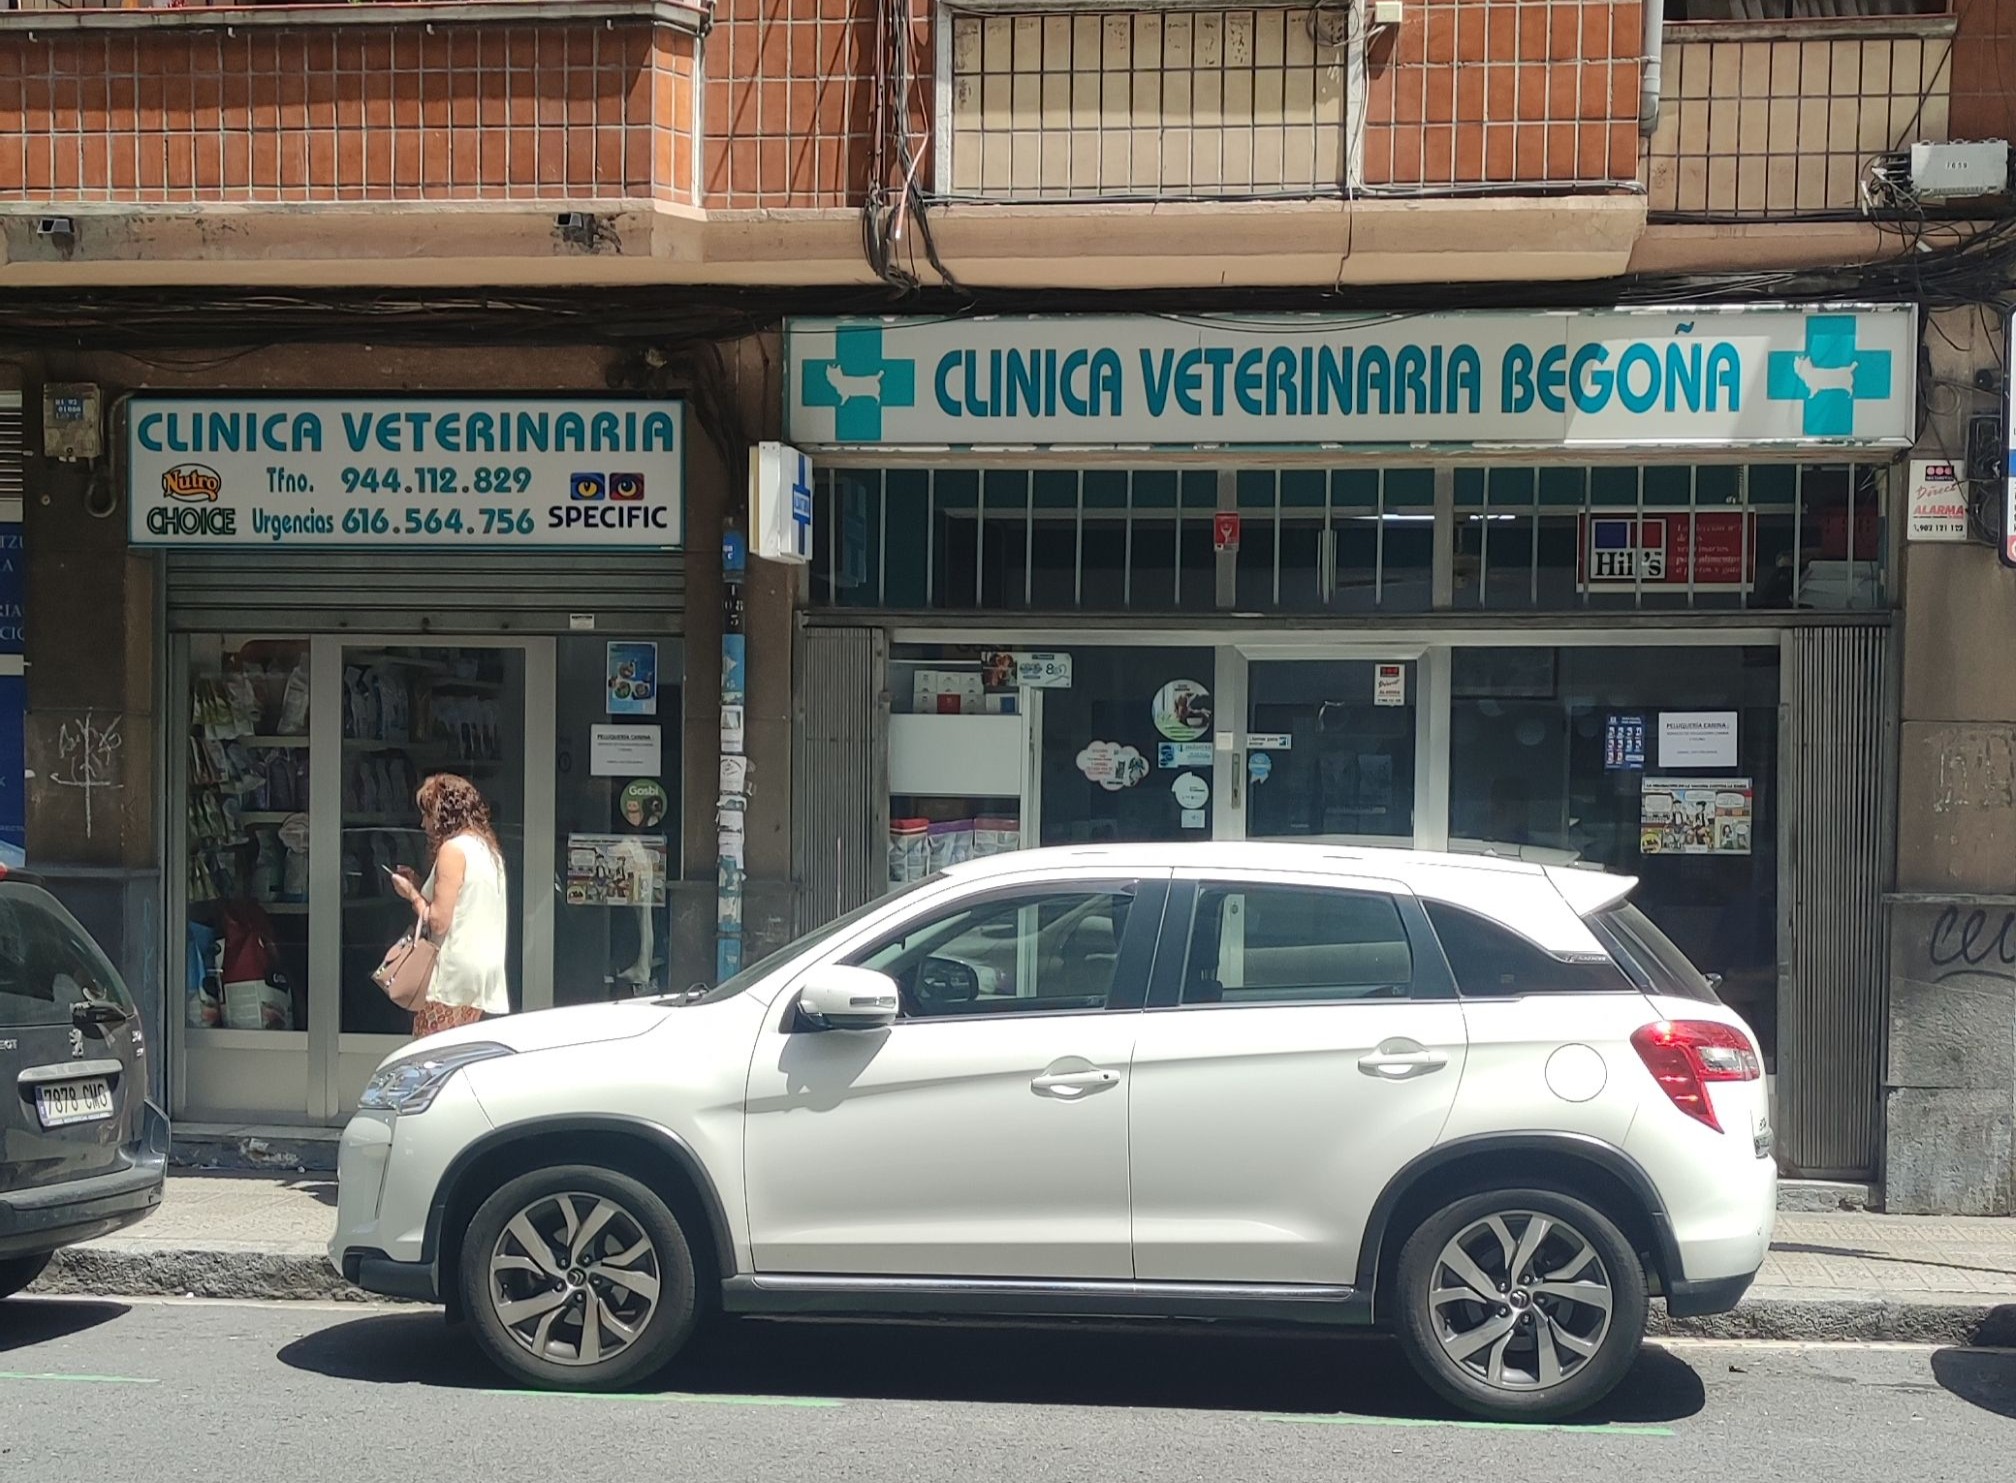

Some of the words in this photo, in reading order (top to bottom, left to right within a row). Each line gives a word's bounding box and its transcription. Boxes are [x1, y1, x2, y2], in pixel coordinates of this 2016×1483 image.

[934, 347, 1122, 418] CLINICA
[1139, 344, 1481, 417] VETERINARIA
[1501, 321, 1741, 413] BEGOÑA
[138, 412, 322, 452] CLINICA
[341, 412, 674, 452] VETERINARIA
[163, 469, 219, 496] Nutro
[266, 467, 314, 493] Tfno.
[341, 467, 532, 494] 944.112.829
[147, 506, 236, 535] CHOICE
[548, 506, 668, 529] SPECIFIC
[1913, 505, 1964, 515] ALARMA
[252, 507, 334, 541] Urgencias
[342, 508, 534, 535] 616.564.756
[1595, 551, 1662, 577] Hil's
[628, 785, 659, 796] Gosbi
